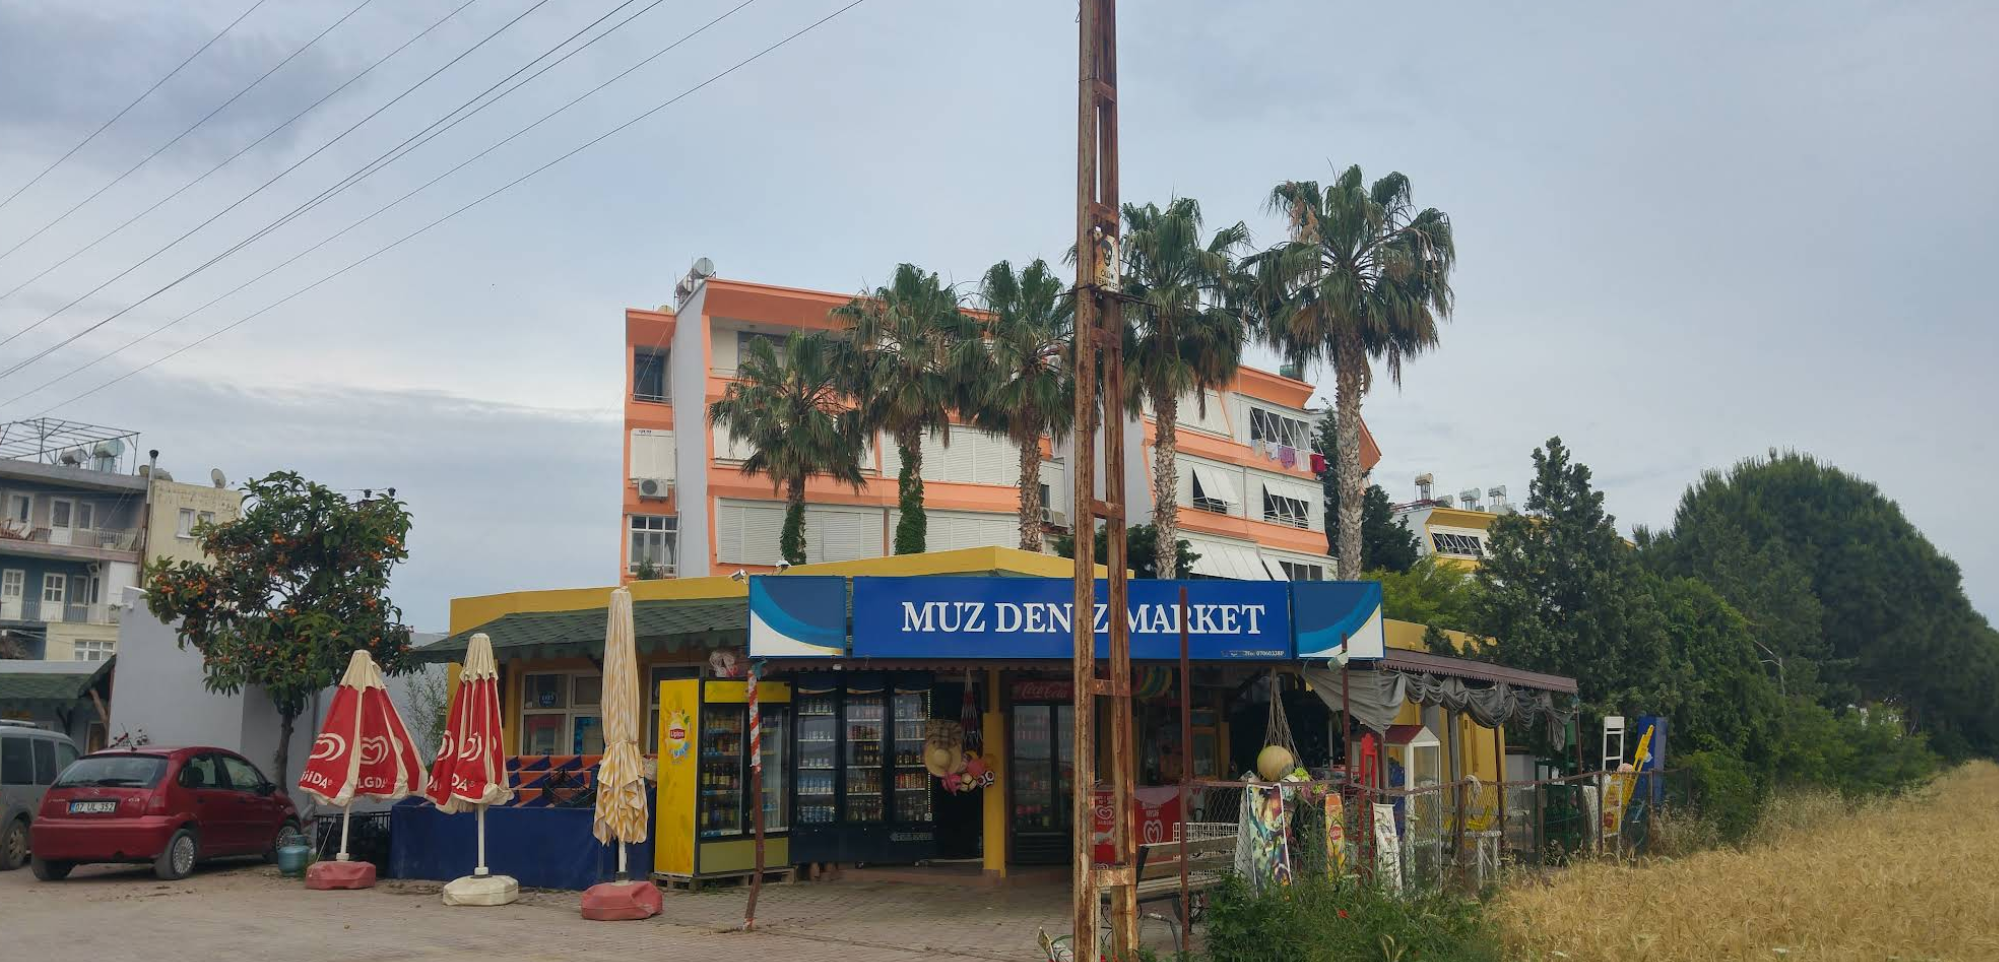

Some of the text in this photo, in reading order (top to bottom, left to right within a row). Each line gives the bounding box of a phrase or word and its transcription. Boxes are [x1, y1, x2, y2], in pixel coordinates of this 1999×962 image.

[901, 601, 1266, 635] MUZ DENZ MARKET
